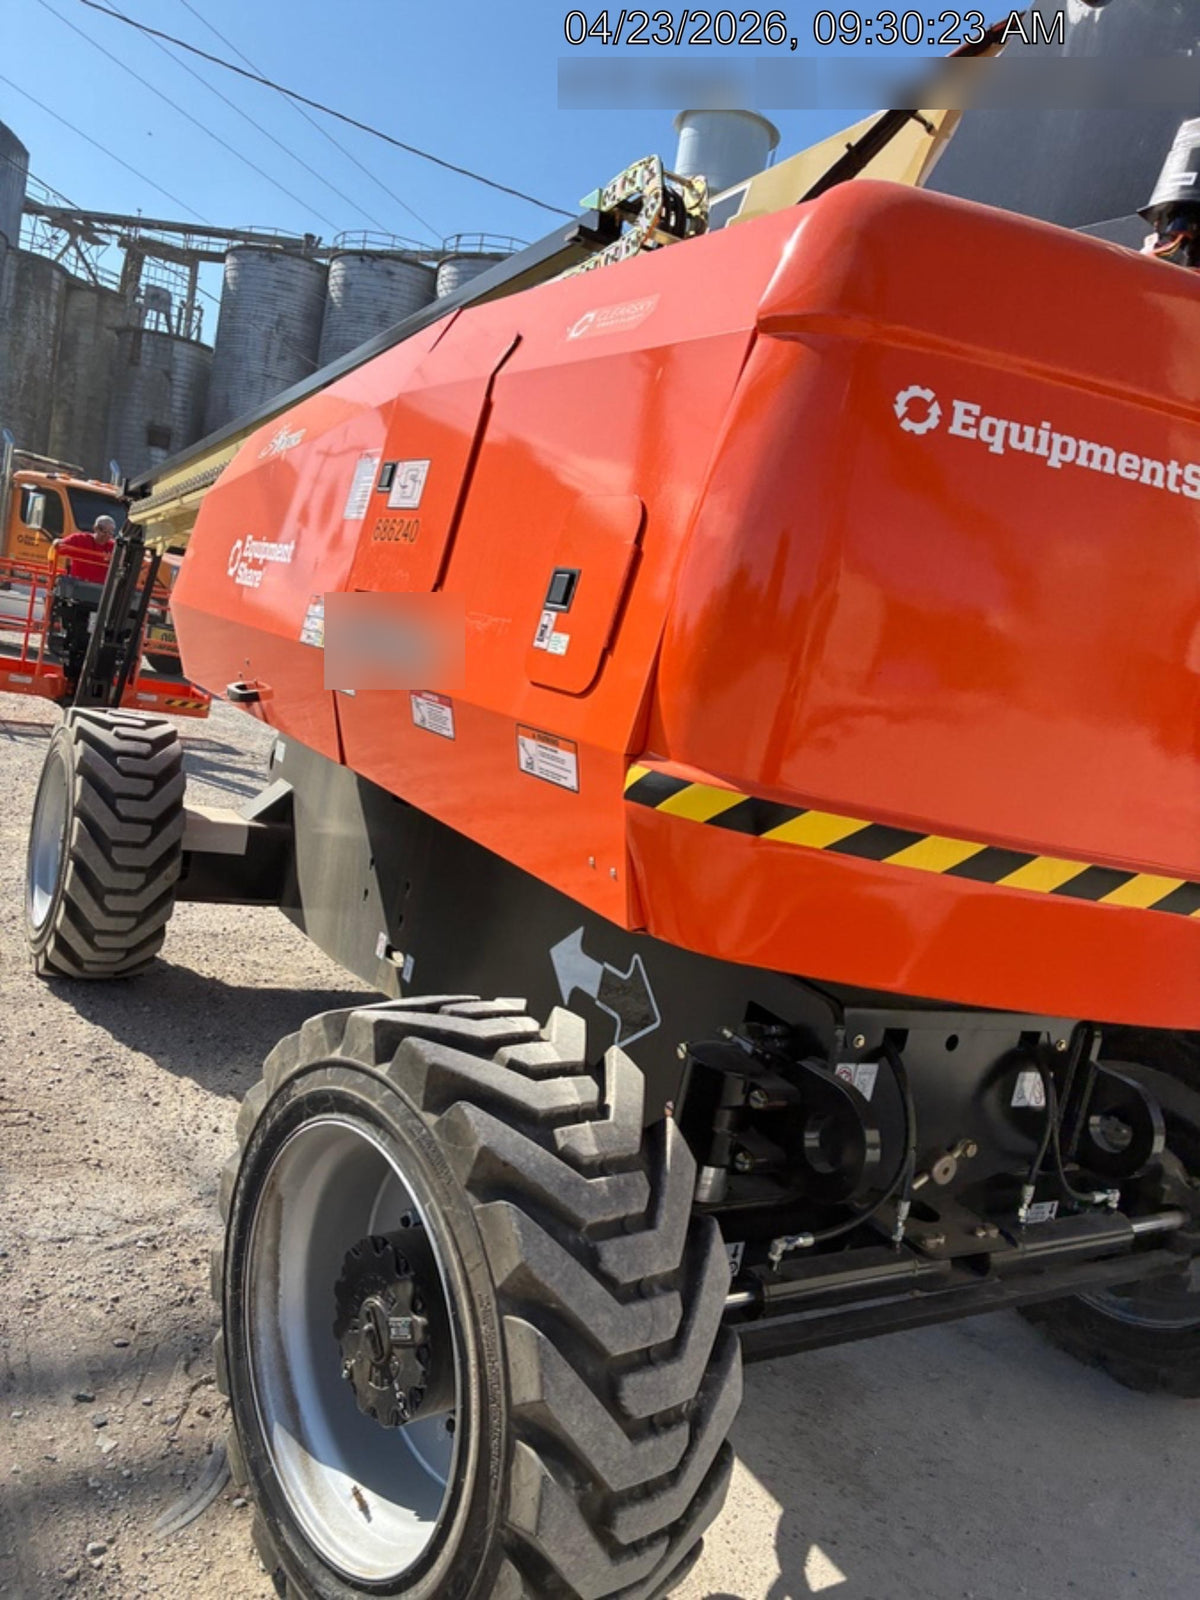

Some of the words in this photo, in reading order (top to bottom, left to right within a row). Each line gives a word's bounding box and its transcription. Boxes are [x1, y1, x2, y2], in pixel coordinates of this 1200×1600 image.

[373, 518, 420, 543] 686240
[243, 535, 295, 564] Equipment
[235, 561, 264, 588] Share
